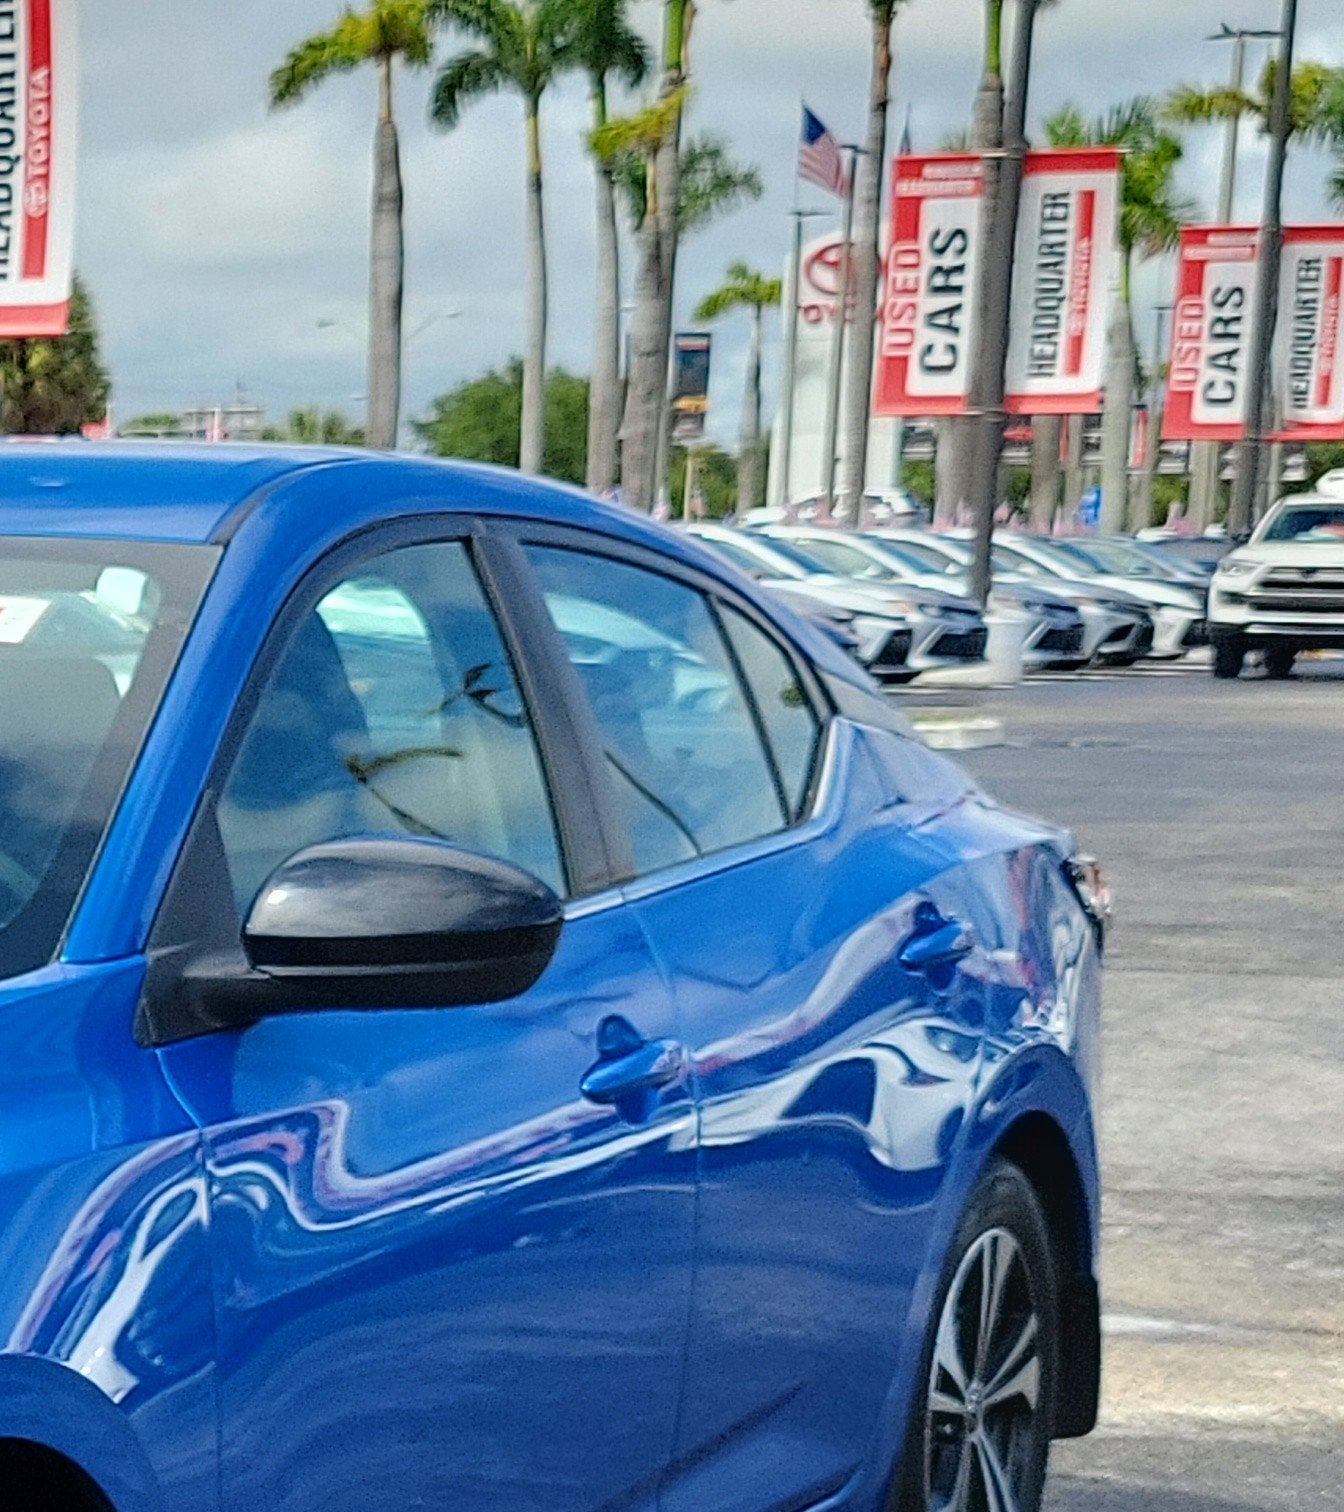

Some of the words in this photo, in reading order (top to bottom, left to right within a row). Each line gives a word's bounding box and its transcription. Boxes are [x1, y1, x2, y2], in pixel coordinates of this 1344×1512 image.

[26, 66, 50, 187] TOYOTA
[887, 247, 921, 348] USED
[920, 227, 969, 374] CARS
[1026, 191, 1069, 378] HEADQUARTER
[1172, 301, 1204, 383] USED
[1291, 257, 1321, 409] HEADQUARTER
[1203, 286, 1244, 406] CARS
